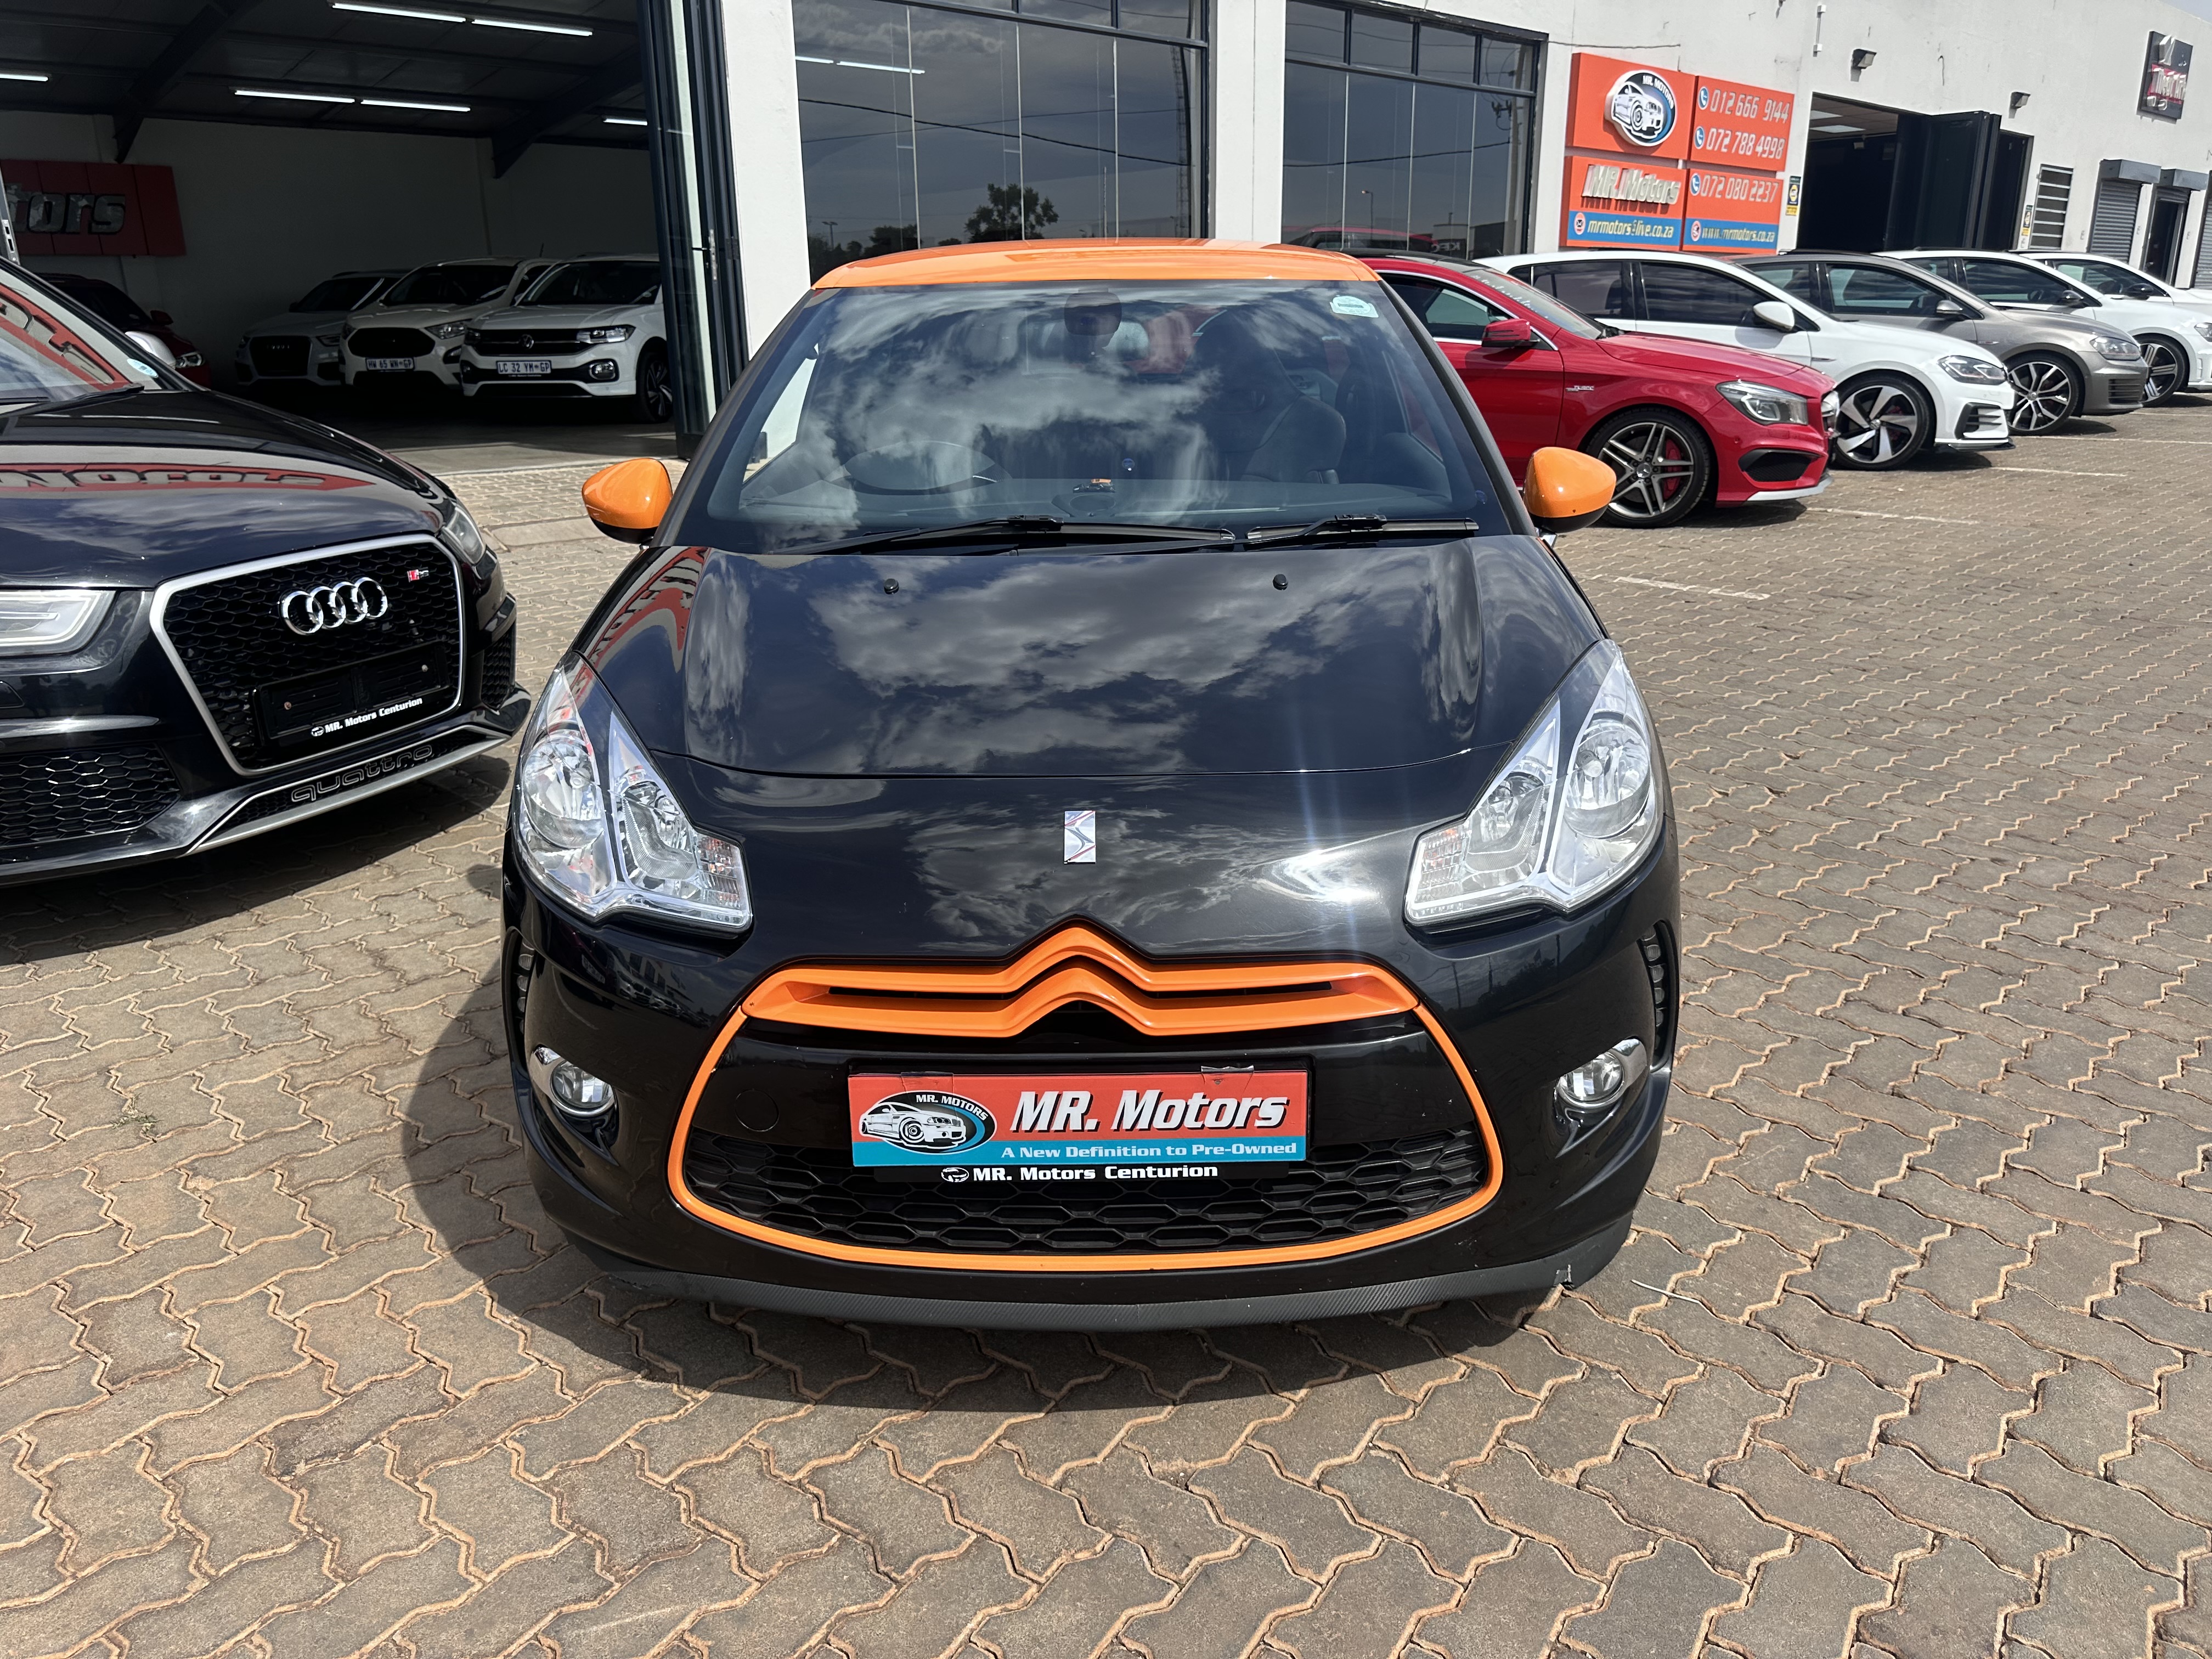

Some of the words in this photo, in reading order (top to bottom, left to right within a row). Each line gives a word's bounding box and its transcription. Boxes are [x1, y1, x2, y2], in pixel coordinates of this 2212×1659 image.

[1654, 78, 1674, 110] MOTORS
[1709, 88, 1736, 115] 012
[1735, 94, 1760, 119] 666
[1762, 99, 1791, 124] 9144
[1706, 127, 1732, 153] 072
[1731, 131, 1756, 156] 788
[1755, 135, 1786, 160] 4998
[1615, 168, 1681, 205] Motors
[1701, 174, 1726, 199] 072
[1725, 177, 1750, 201] 080
[1748, 179, 1779, 204] 2237
[1702, 227, 1776, 242] www.mrmotors.co.za
[511, 363, 521, 373] 32
[540, 362, 550, 372] GP
[325, 721, 343, 733] MR.
[345, 711, 377, 727] Motors
[379, 697, 423, 717] Centurion
[291, 744, 432, 802] quattro
[916, 1094, 939, 1104] MR.
[941, 1094, 989, 1121] MOTORS
[1009, 1090, 1099, 1132] MR.
[1110, 1089, 1289, 1129] Motors
[1001, 1147, 1015, 1158] A
[1019, 1147, 1060, 1158] New
[1065, 1146, 1161, 1158] Definition
[1165, 1146, 1187, 1156] to
[1192, 1142, 1297, 1156] Pre-Owned
[973, 1167, 1013, 1181] MR.
[1020, 1166, 1096, 1181] Motors
[1104, 1165, 1218, 1180] Centurion
